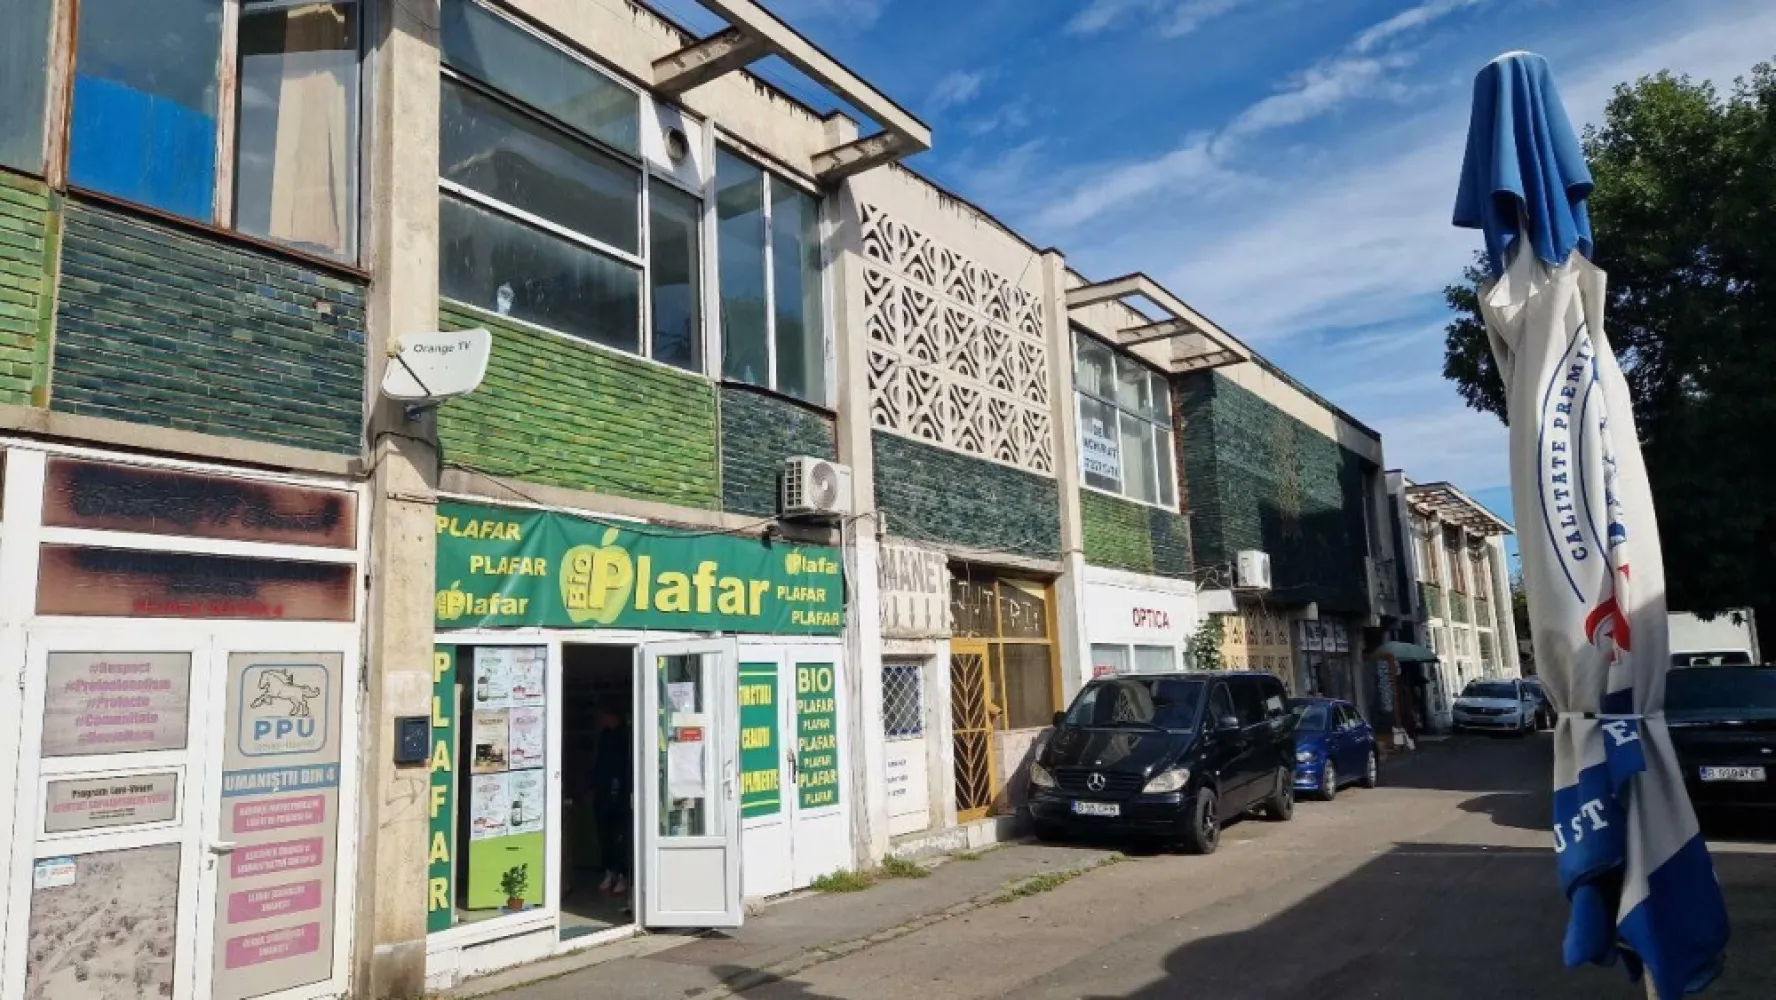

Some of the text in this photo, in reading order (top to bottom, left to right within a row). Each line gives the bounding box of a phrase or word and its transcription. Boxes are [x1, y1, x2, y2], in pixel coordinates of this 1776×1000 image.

[413, 340, 471, 355] Orange TV
[1552, 441, 1588, 561] CALITATE
[435, 515, 521, 541] PLAFAR
[470, 555, 548, 576] PLAFAR
[588, 551, 770, 615] Plafar
[777, 585, 826, 603] PLAFAR
[792, 610, 839, 626] PLAFAR
[1133, 607, 1169, 629] OPTICA
[798, 667, 832, 693] BIO
[798, 698, 834, 713] PLAFAR
[254, 719, 315, 741] PPU
[799, 735, 836, 752] PLAFAR
[301, 768, 324, 784] DIN
[326, 767, 335, 782] 4
[429, 651, 452, 912] PLAFAR
[799, 769, 837, 788] PLAFAR
[72, 788, 108, 799] Program
